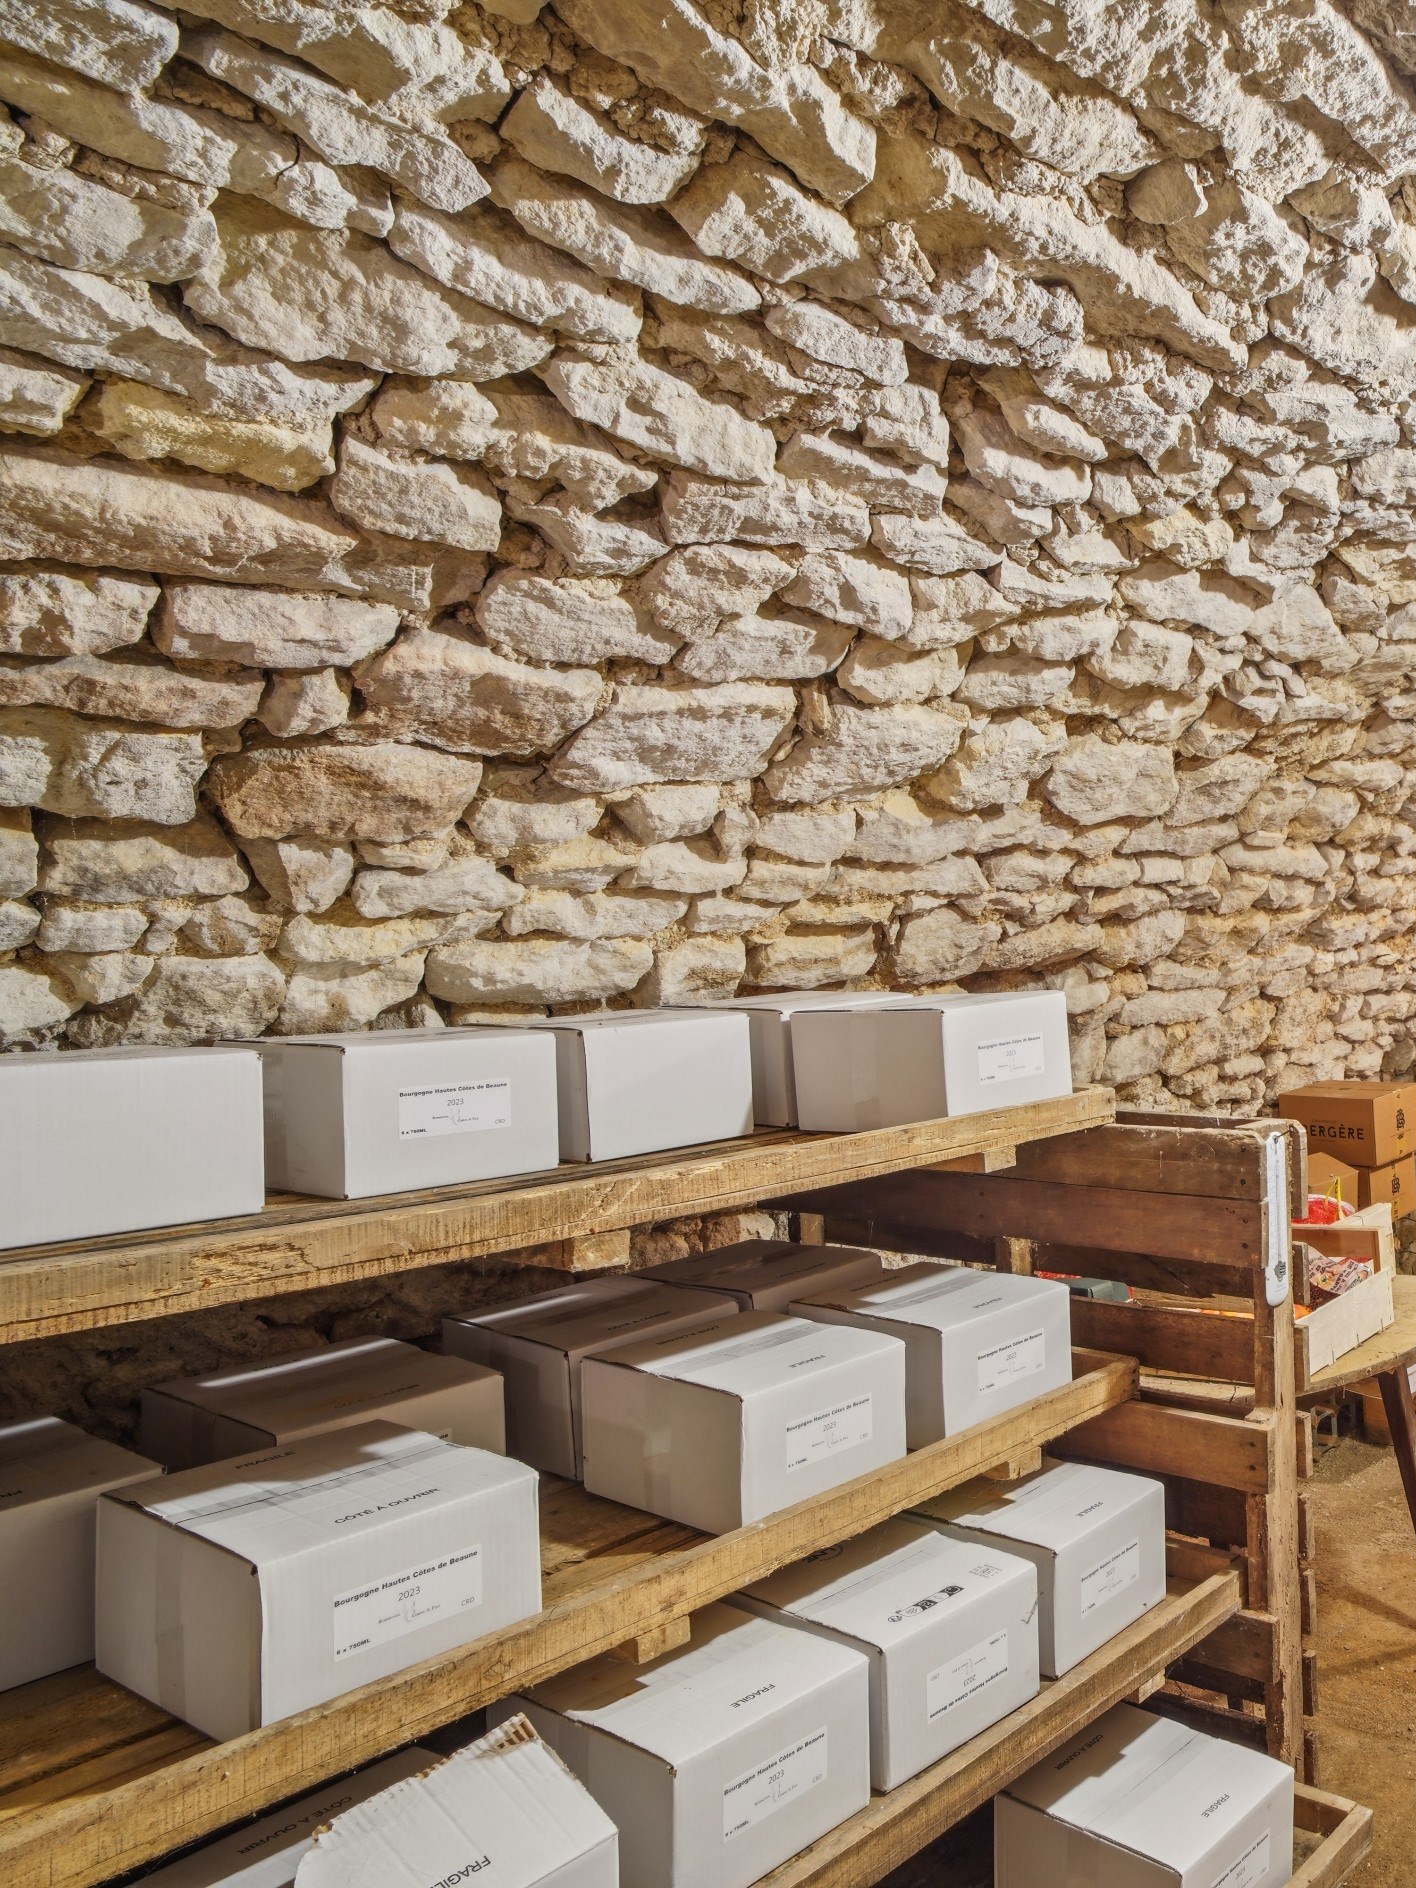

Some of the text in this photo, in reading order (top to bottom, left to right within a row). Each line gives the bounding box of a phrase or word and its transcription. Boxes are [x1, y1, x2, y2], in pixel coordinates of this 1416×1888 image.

[399, 1090, 433, 1098] Bourgogne
[447, 1098, 464, 1107] 2023
[786, 1419, 813, 1432] Bourgogne
[813, 1413, 830, 1422] Hautes
[852, 1398, 870, 1407] Beaune
[823, 1421, 837, 1432] 2023
[235, 1451, 297, 1469] FRAGILE
[334, 1509, 375, 1525] CÔTE
[388, 1487, 440, 1507] OUVRIR
[334, 1586, 379, 1608] Bourgogne
[382, 1576, 411, 1590] Hautes
[413, 1566, 436, 1579] Côtes
[449, 1550, 478, 1565] Beaune
[398, 1586, 421, 1601] 2023
[461, 1596, 475, 1607] CRD
[348, 1638, 371, 1650] 750ML
[730, 1683, 776, 1709] FRAGILE
[724, 1773, 756, 1796] Bourgogne
[757, 1761, 778, 1776] Hautes
[796, 1745, 804, 1753] de
[804, 1732, 825, 1748] Beaune
[768, 1769, 785, 1785] 2023
[312, 1796, 352, 1818] CÔTE
[1201, 1793, 1230, 1818] FRAGILE
[237, 1823, 298, 1854] OUVRIR
[430, 1856, 492, 1888] FRAGIL
